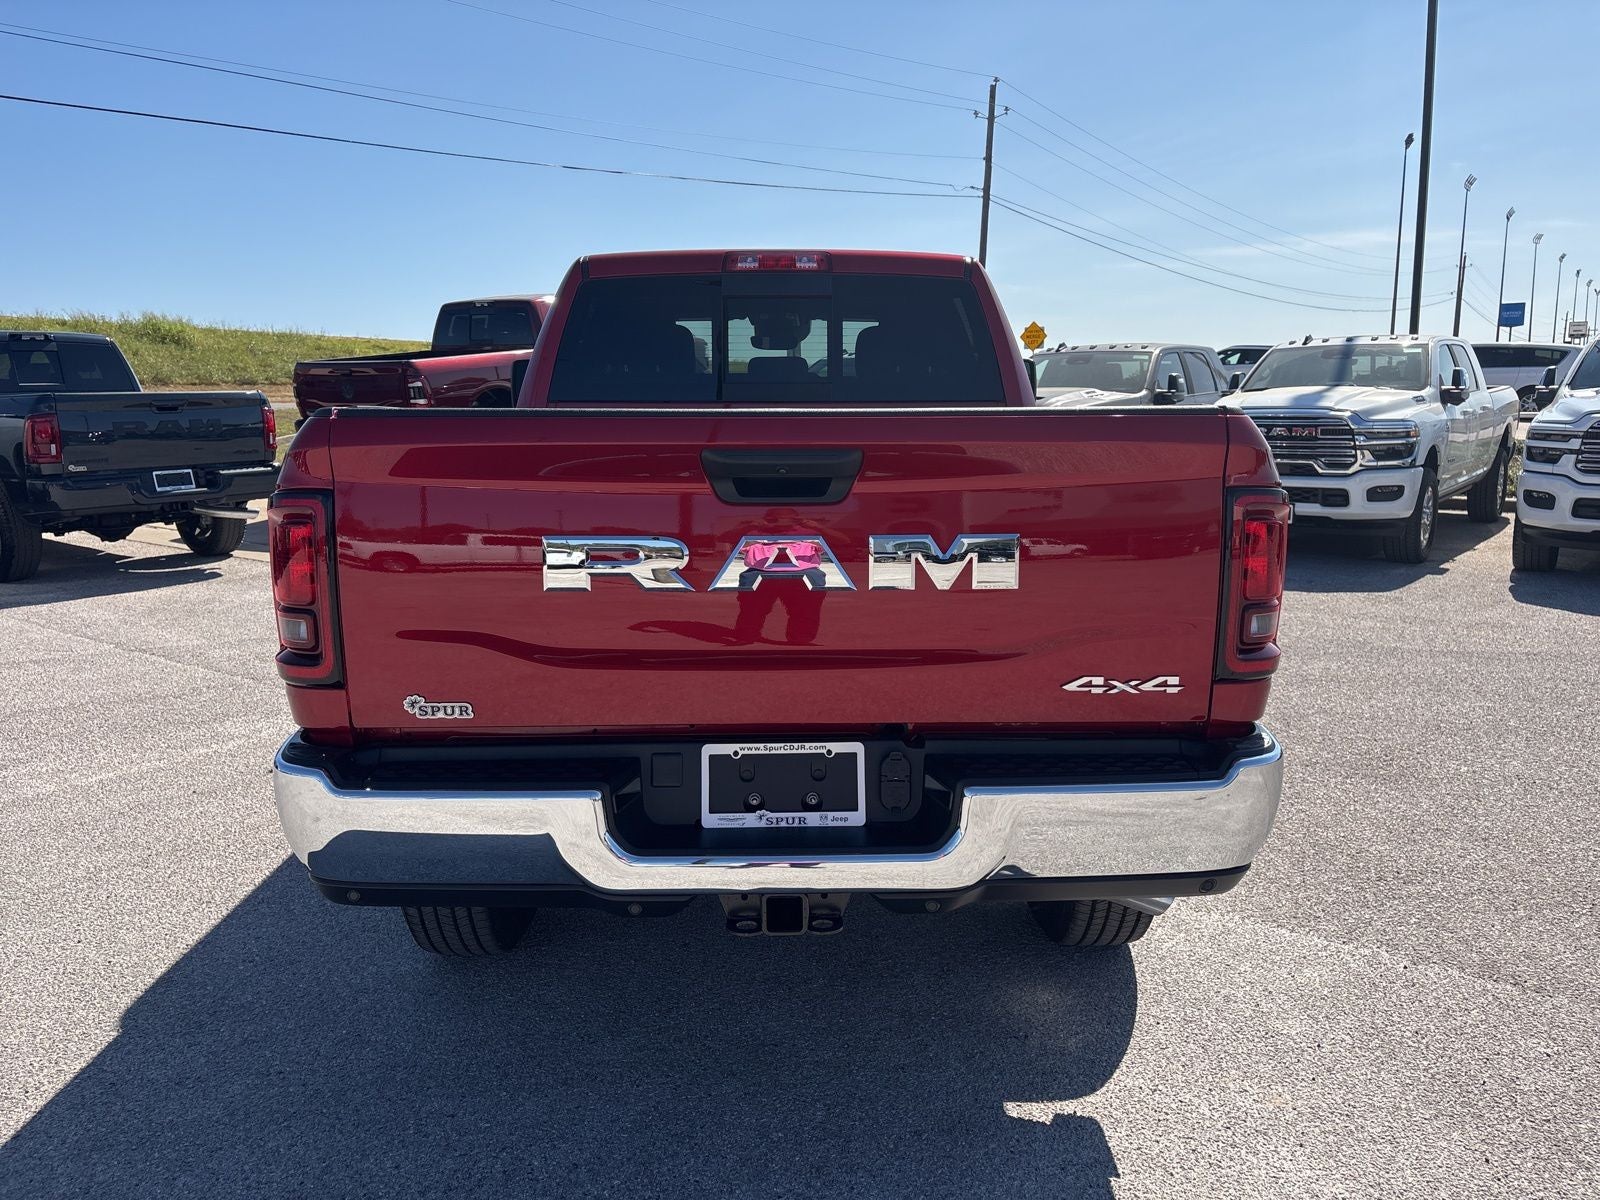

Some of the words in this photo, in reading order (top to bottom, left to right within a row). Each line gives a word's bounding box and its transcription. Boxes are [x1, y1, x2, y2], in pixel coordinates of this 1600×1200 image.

[112, 419, 223, 437] RAM
[542, 535, 1020, 591] RAM
[1061, 676, 1185, 694] 4x4
[418, 705, 471, 717] SPUR
[739, 744, 827, 753] www.SpurCDJR.com
[765, 816, 807, 826] SPUR
[830, 815, 849, 823] Jeep
